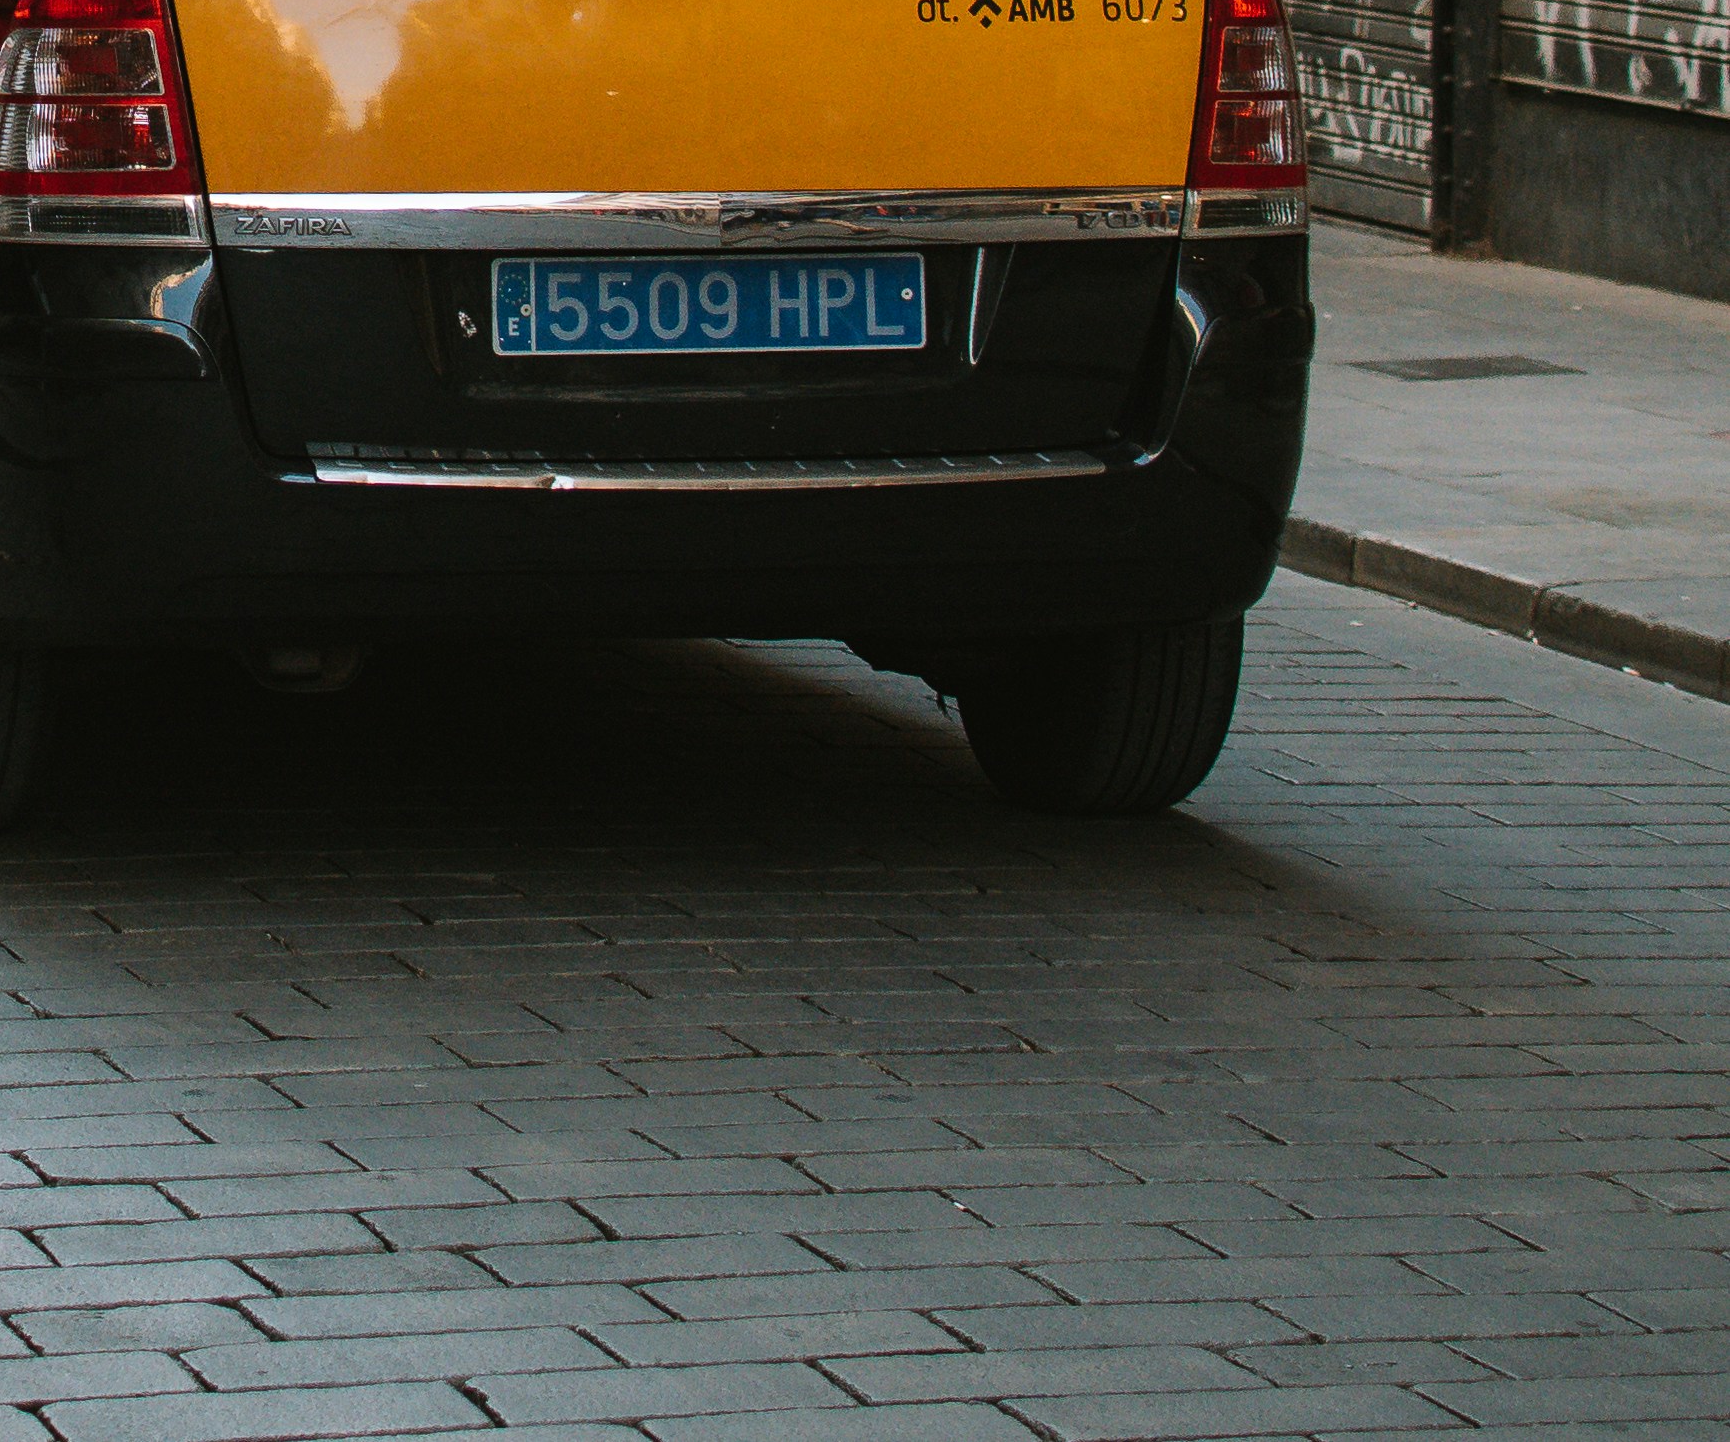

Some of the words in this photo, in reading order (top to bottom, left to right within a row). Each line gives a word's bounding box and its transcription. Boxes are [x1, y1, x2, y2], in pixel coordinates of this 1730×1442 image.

[235, 216, 352, 236] ZAFIRA
[547, 270, 738, 341] 5509
[770, 268, 905, 338] HPL
[507, 317, 520, 337] E
